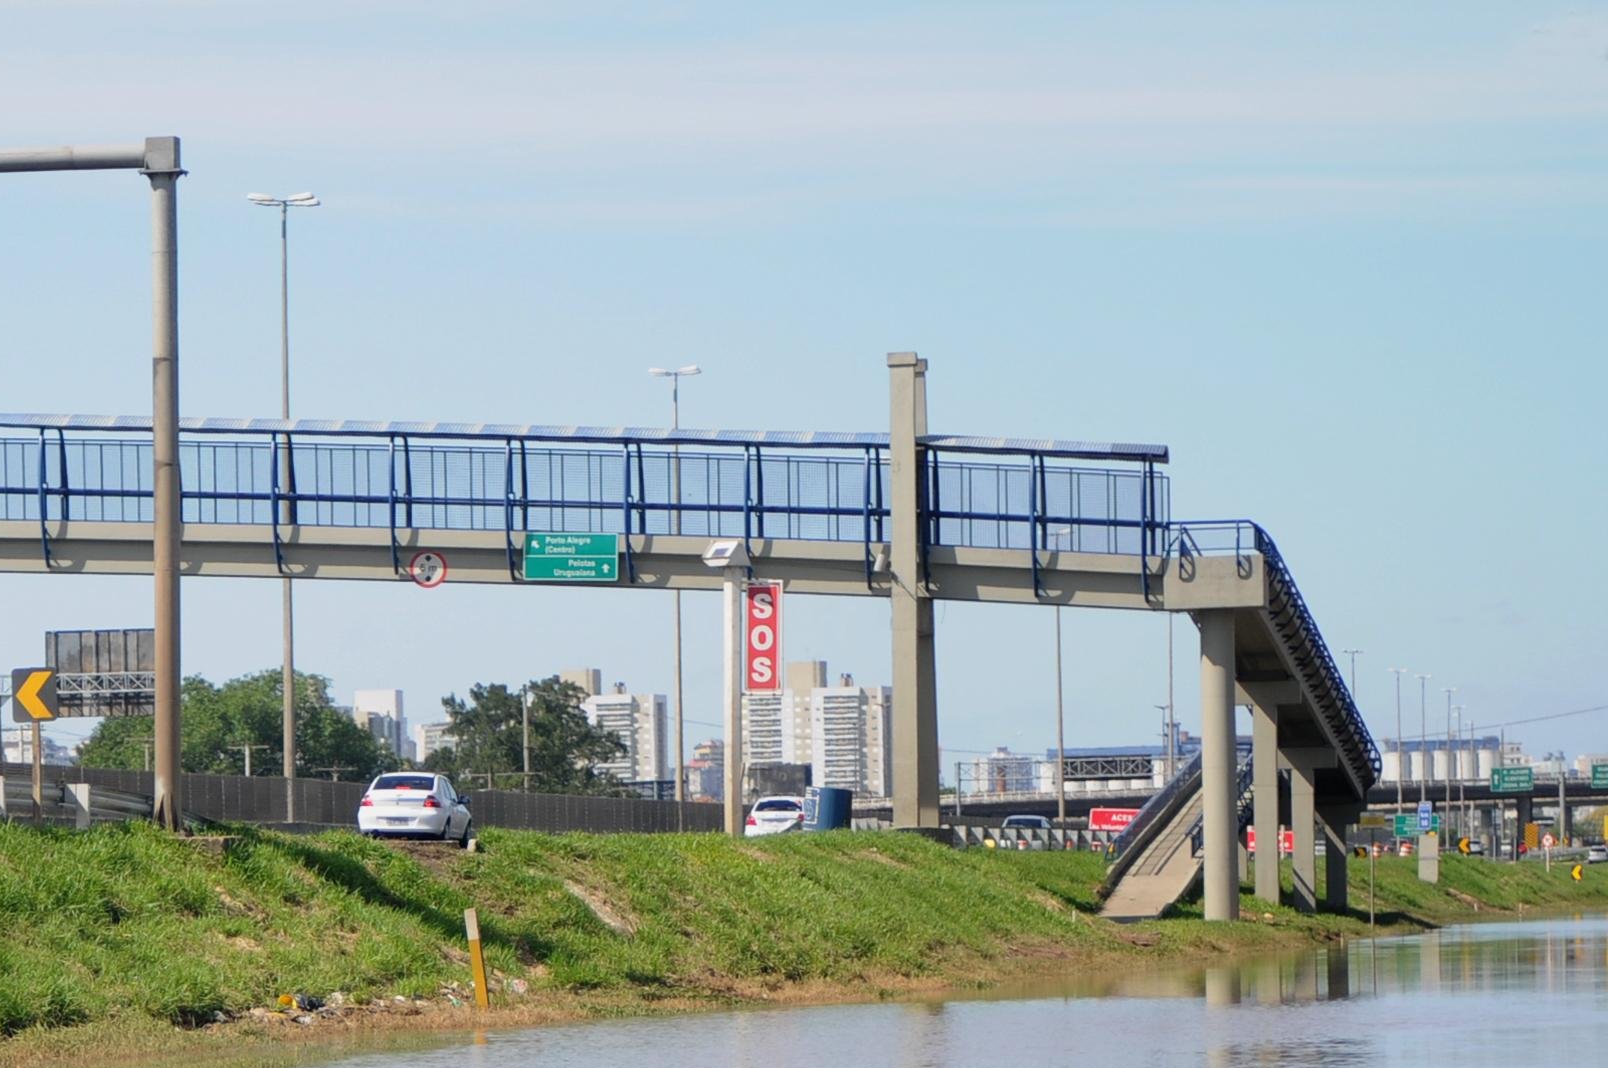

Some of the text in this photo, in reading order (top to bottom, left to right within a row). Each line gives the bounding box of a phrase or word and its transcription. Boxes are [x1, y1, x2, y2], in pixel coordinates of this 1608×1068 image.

[544, 536, 591, 546] Porto Alegre
[544, 545, 576, 555] (Centro)
[751, 593, 774, 683] SOS
